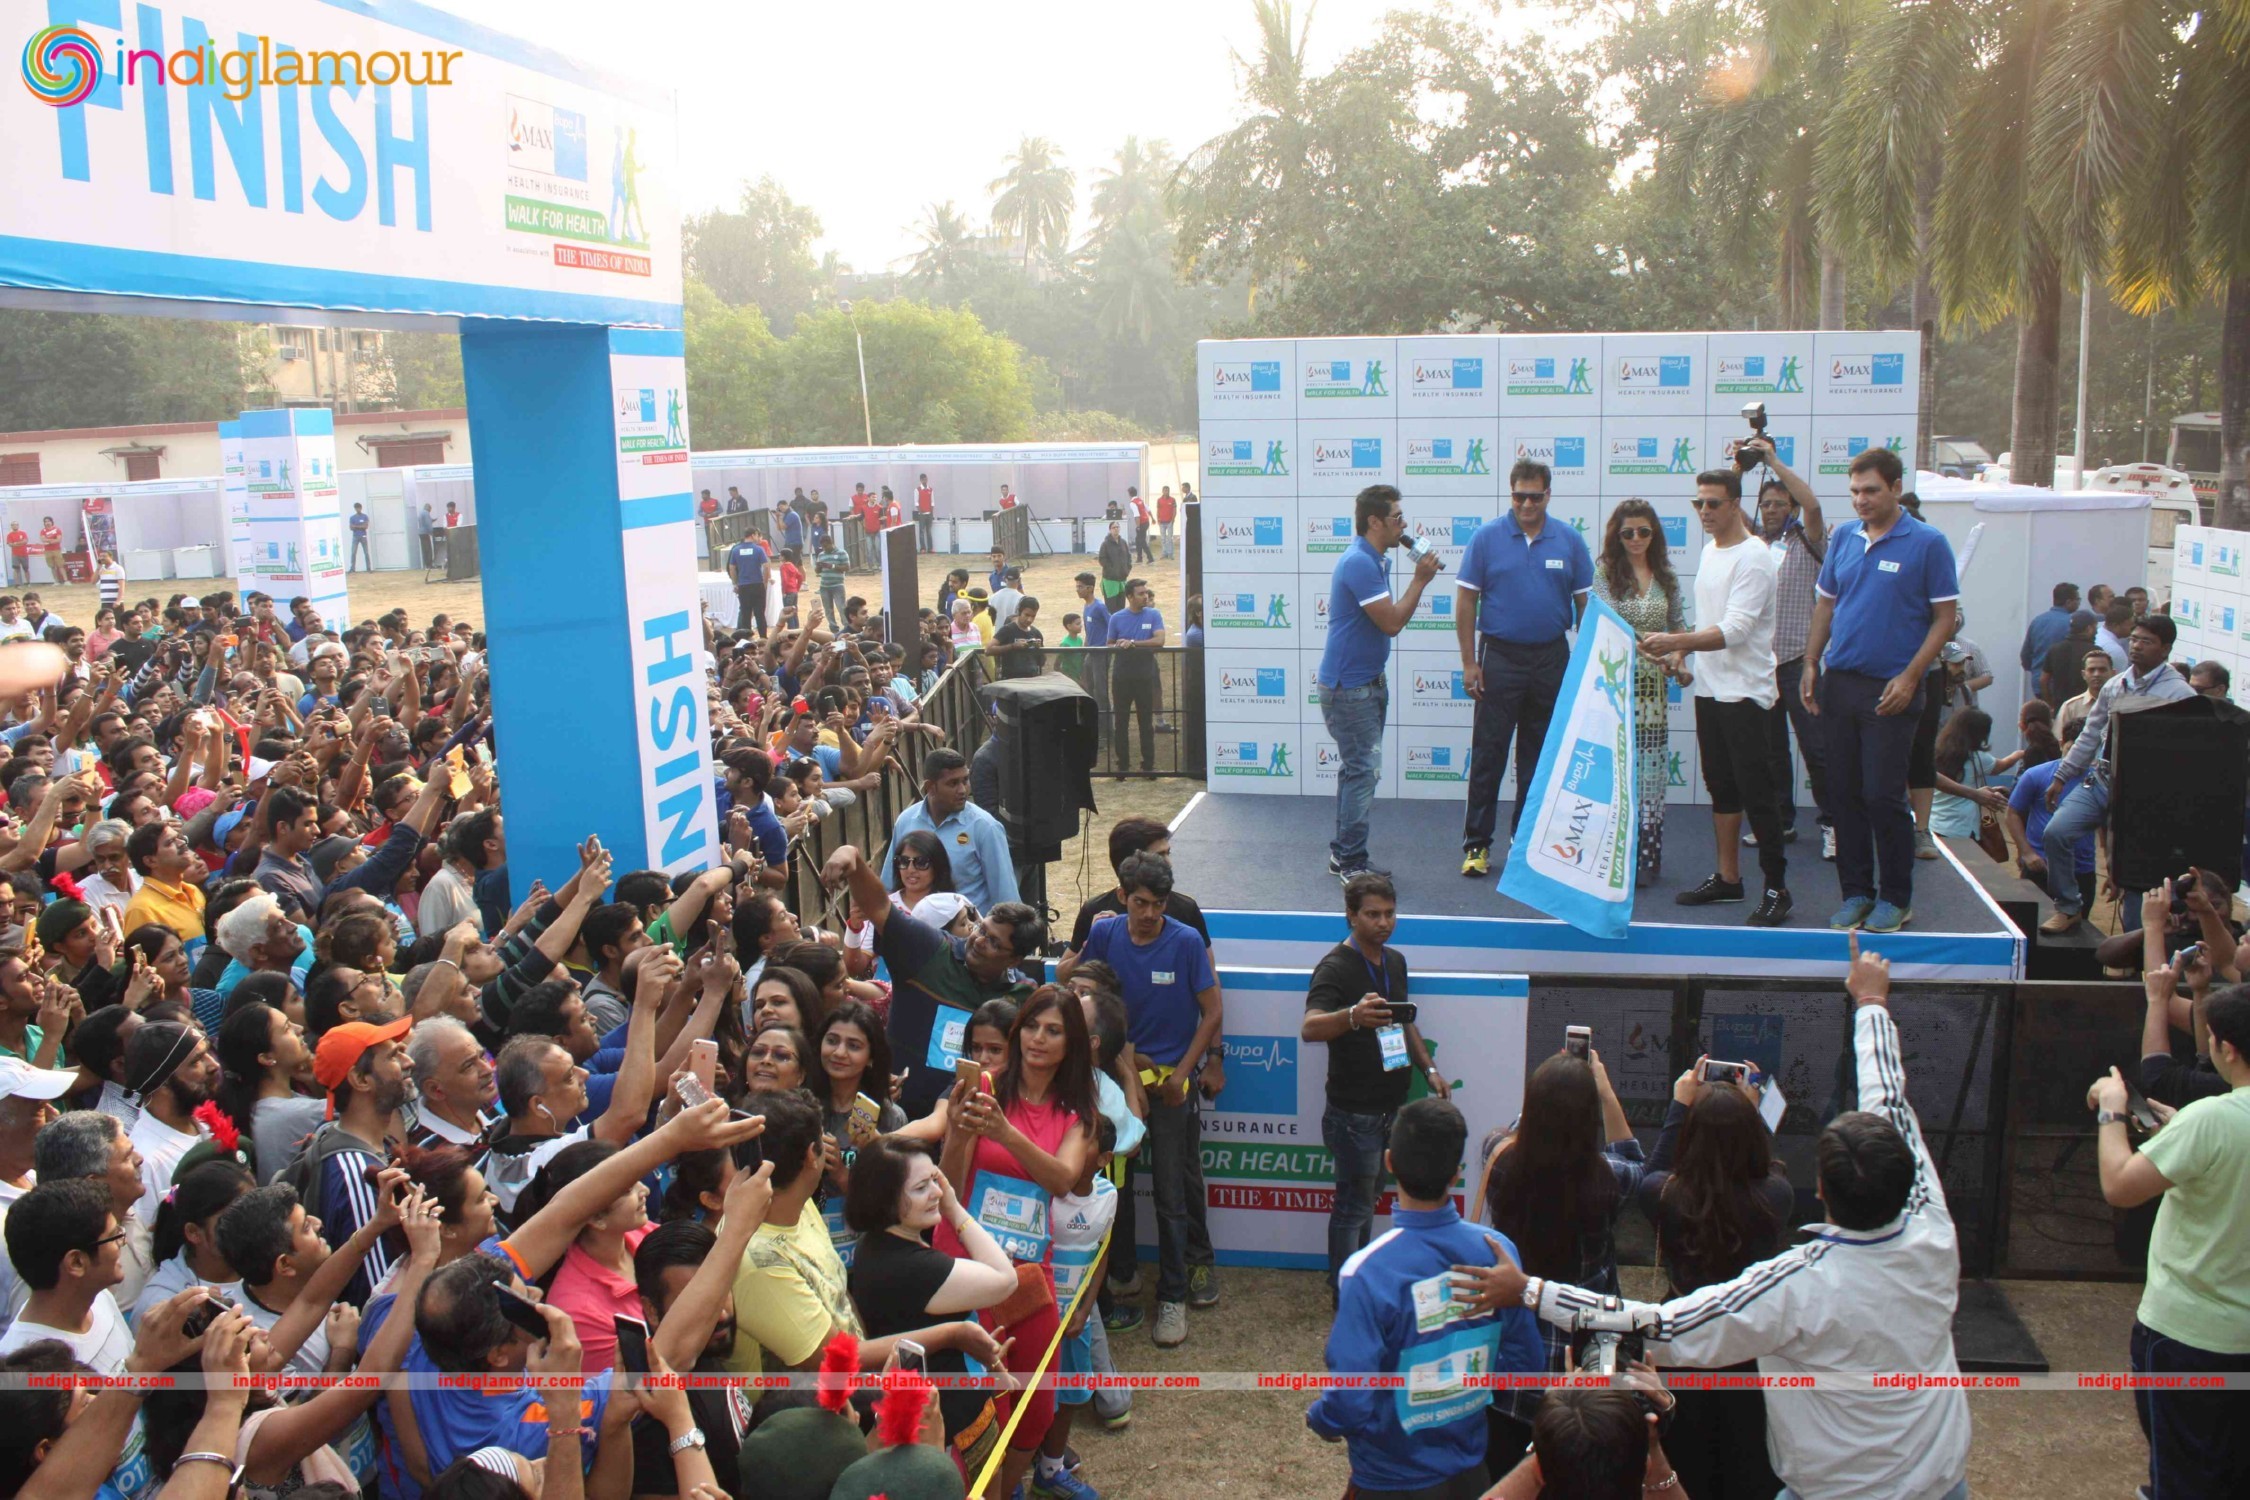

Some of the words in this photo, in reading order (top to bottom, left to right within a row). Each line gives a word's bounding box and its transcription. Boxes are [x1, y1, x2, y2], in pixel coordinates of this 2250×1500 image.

[47, 0, 433, 232] FINISH
[522, 124, 552, 150] MAX
[507, 176, 540, 192] HEALTH
[544, 184, 590, 201] INSURANCE
[508, 202, 539, 226] WALK
[543, 209, 564, 229] FOR
[566, 213, 606, 237] HEALTH
[557, 249, 577, 264] THE
[580, 251, 608, 267] TIMES
[610, 254, 624, 269] OF
[625, 256, 650, 275] INDIA
[1661, 357, 1680, 366] Bupa
[1873, 354, 1892, 364] Bupa
[1252, 363, 1270, 372] Bupa
[1453, 360, 1471, 369] Bupa
[1425, 368, 1451, 379] MAX
[1632, 367, 1658, 377] MAX
[1843, 365, 1871, 376] MAX
[1225, 373, 1250, 382] MAX
[1322, 389, 1333, 397] FOR
[1334, 389, 1360, 397] HEALTH
[1733, 384, 1745, 392] FOR
[1747, 384, 1774, 392] HEALTH
[625, 400, 640, 412] MAX
[621, 439, 636, 449] WALK
[636, 438, 647, 448] FOR
[647, 437, 666, 447] HEALTH
[1353, 440, 1370, 449] Bupa
[1325, 449, 1350, 459] MAX
[1527, 447, 1553, 458] MAX
[643, 456, 653, 464] THE
[653, 455, 667, 463] TIMES
[667, 454, 674, 462] OF
[674, 453, 687, 461] INDIA
[1255, 518, 1272, 527] Bupa
[1453, 518, 1471, 527] Bupa
[1228, 527, 1253, 537] MAX
[1425, 527, 1451, 537] MAX
[1435, 622, 1457, 630] HEALT
[1258, 670, 1274, 678] Bupa
[1231, 677, 1256, 687] MAX
[1425, 680, 1450, 690] MAX
[1421, 773, 1434, 781] FOR
[1435, 773, 1460, 781] HEALTH
[1566, 761, 1585, 792] Bupa
[1565, 798, 1594, 845] MAX
[1597, 830, 1614, 880] HEALTH
[1613, 837, 1625, 884] WALK
[1388, 1055, 1407, 1065] CREW
[1619, 1080, 1669, 1091] HEALT
[1200, 1120, 1298, 1136] NSURANCE
[1201, 1149, 1233, 1171] OR
[1240, 1153, 1335, 1176] HEALTH
[1214, 1188, 1262, 1205] THE
[1066, 1222, 1090, 1231] adidas
